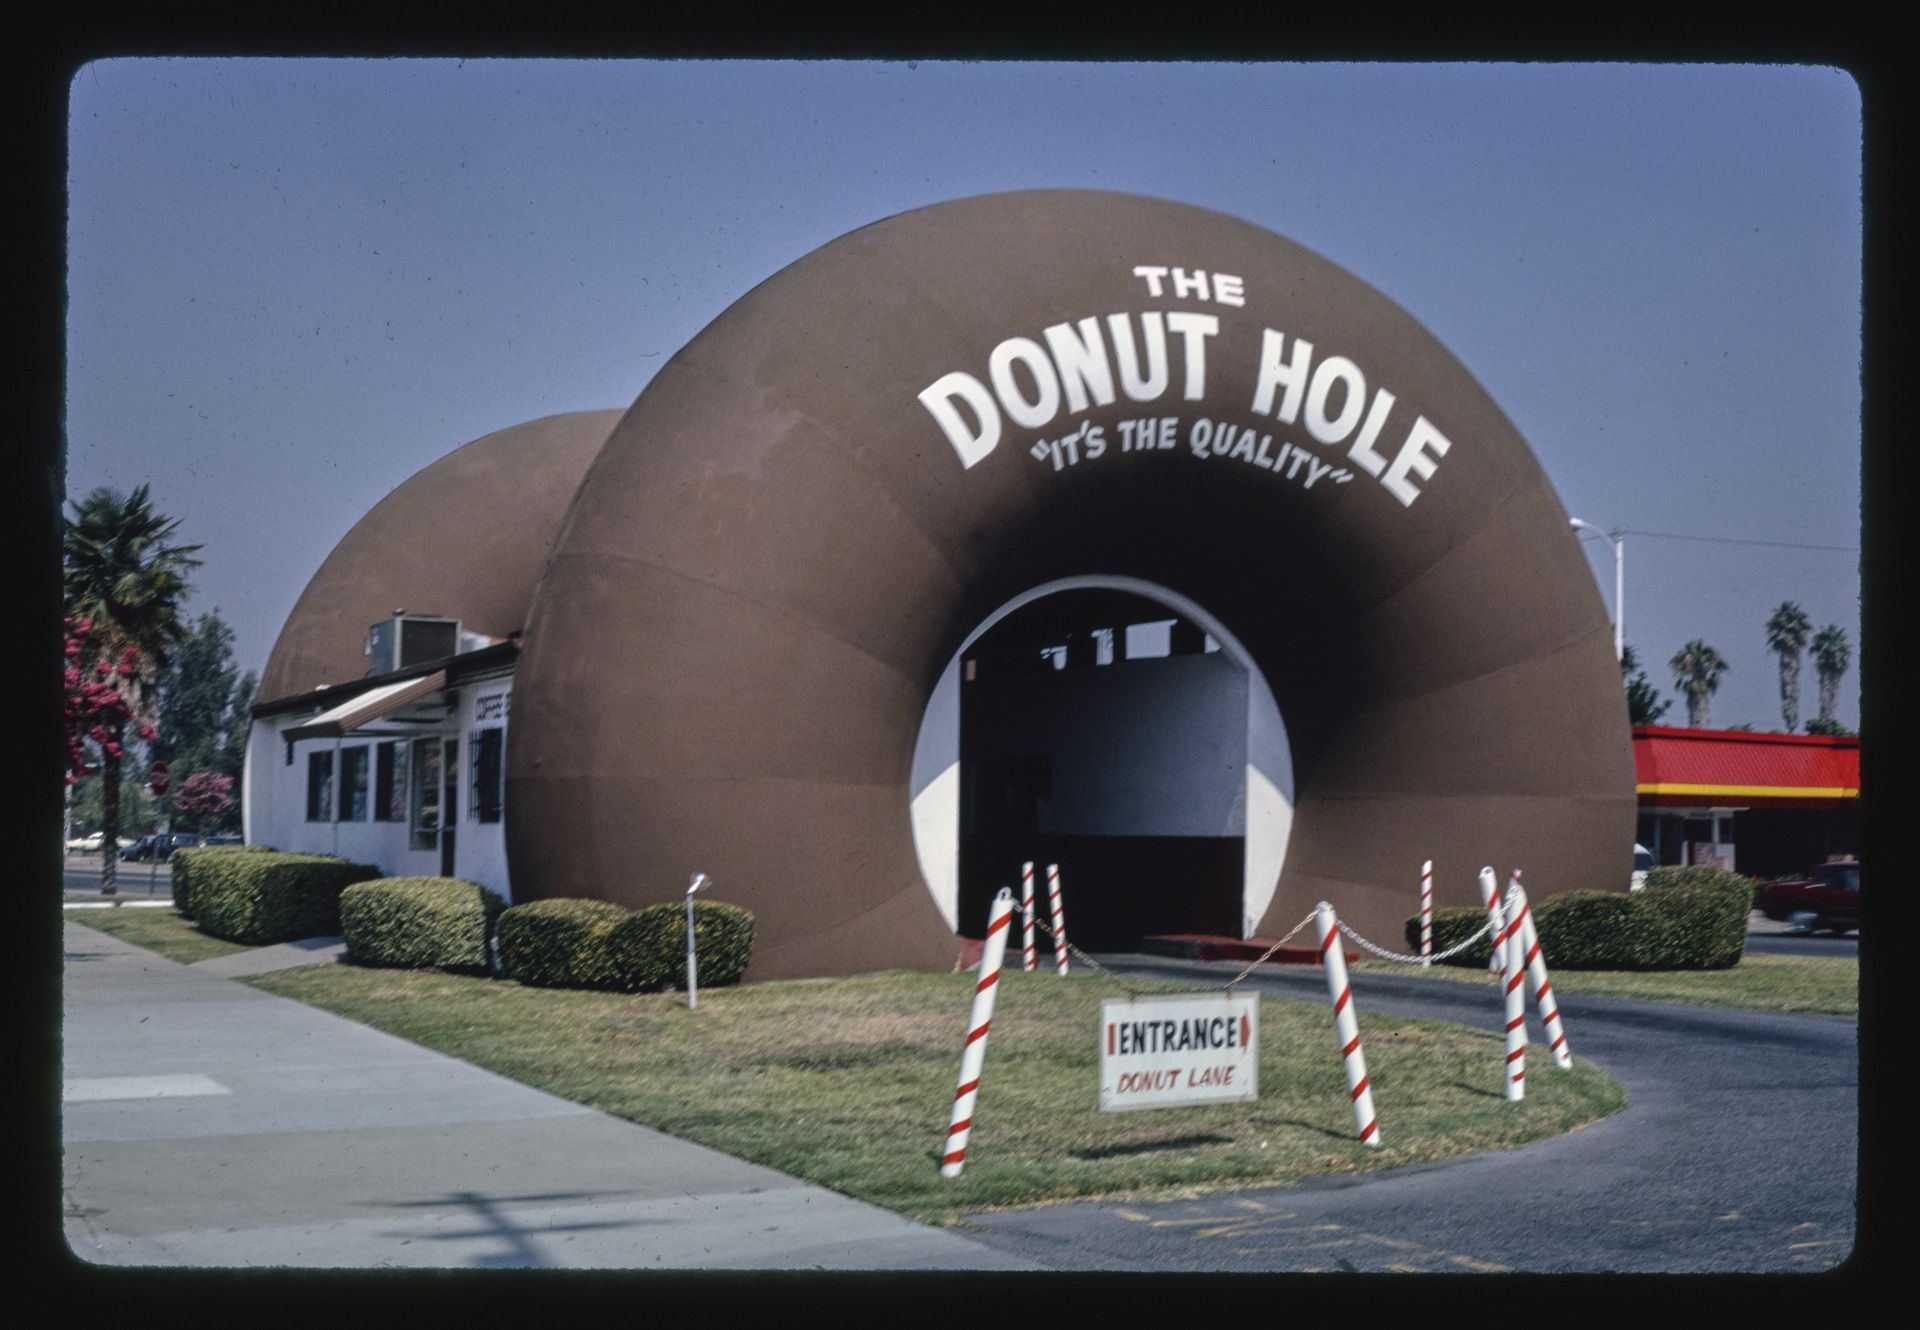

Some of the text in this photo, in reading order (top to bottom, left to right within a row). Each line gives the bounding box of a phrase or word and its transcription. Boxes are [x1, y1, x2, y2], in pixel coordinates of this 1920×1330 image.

[1132, 265, 1245, 307] THE
[917, 311, 1453, 508] DONUT HOLE
[1117, 417, 1178, 452] THE
[1119, 1016, 1238, 1055] ENTRANCE
[1116, 1065, 1236, 1094] DONUT LANE
